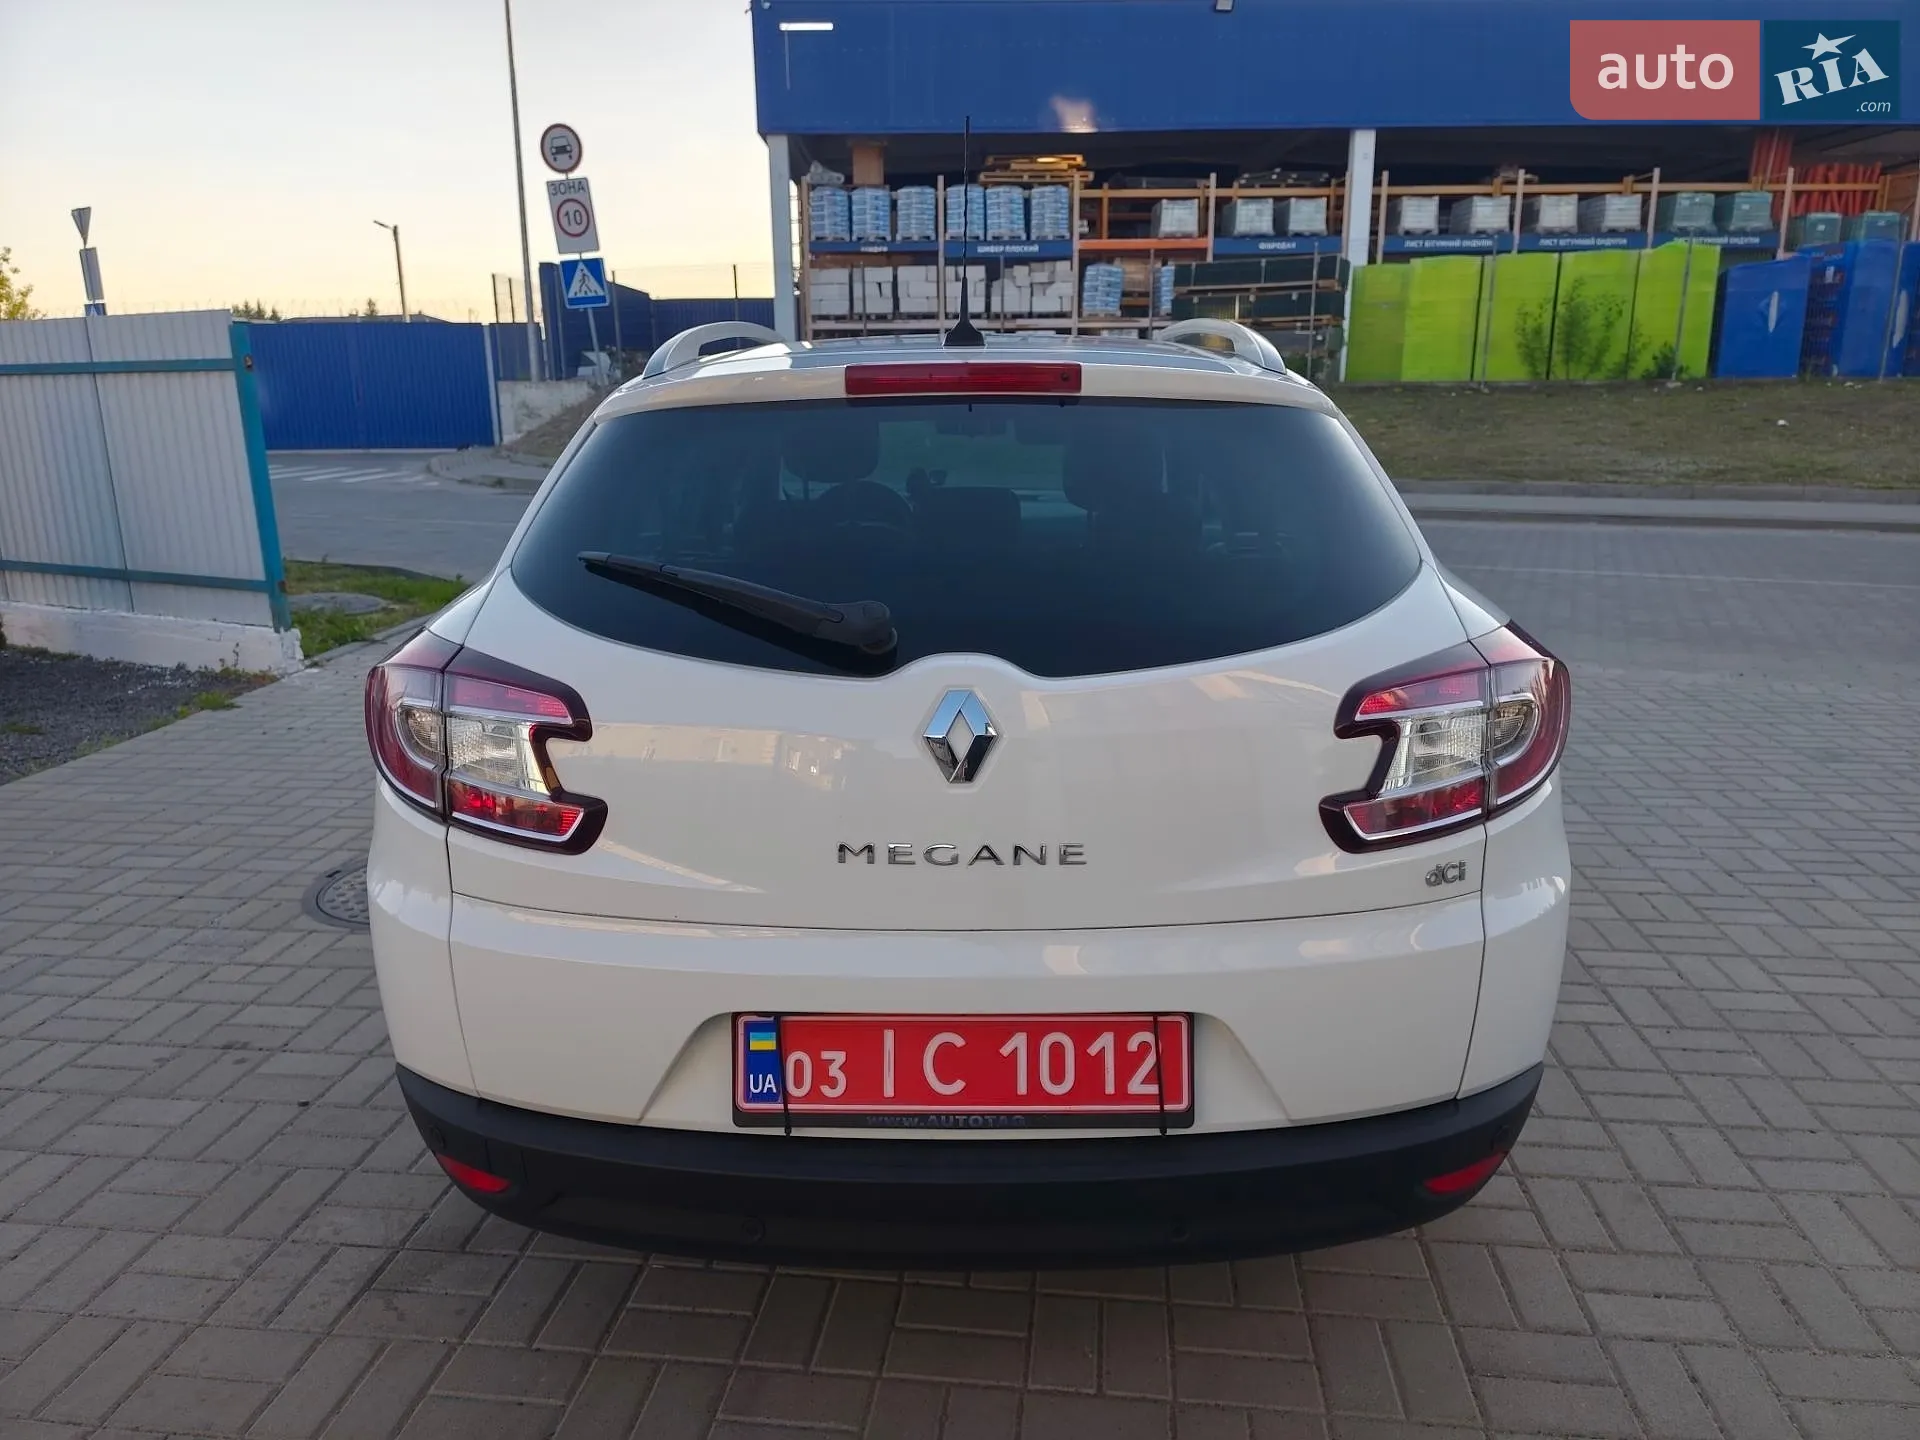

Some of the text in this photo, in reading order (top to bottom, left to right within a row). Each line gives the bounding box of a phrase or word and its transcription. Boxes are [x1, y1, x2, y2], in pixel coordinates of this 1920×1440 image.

[550, 180, 587, 197] ЗОНА
[563, 208, 584, 227] 10
[837, 843, 1087, 867] MEGANE
[785, 1050, 848, 1098] 03
[999, 1031, 1164, 1096] 1012
[749, 1073, 777, 1094] UA
